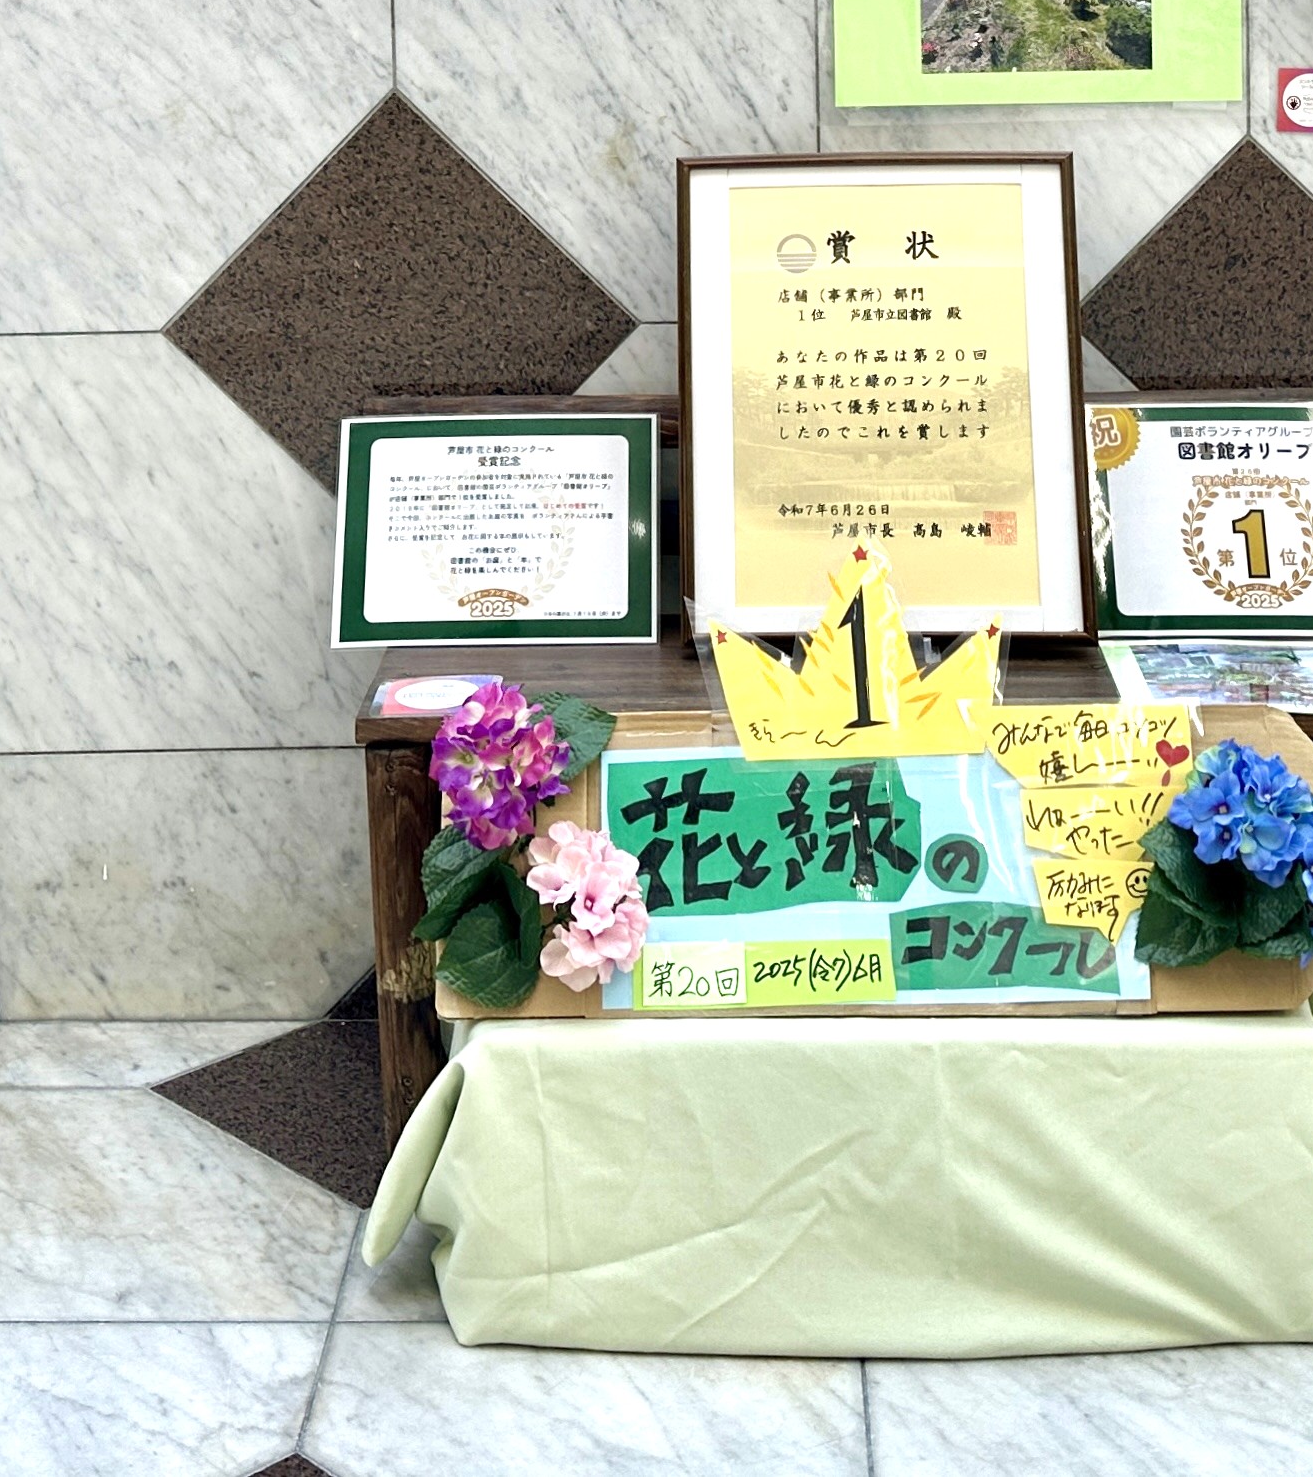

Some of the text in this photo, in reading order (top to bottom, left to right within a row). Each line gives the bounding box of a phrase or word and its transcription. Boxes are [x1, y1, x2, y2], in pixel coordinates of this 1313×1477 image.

[850, 308, 932, 322] 芦屋市立図書館
[947, 306, 962, 321] 殿
[776, 348, 987, 364] あなたの作品は第20回
[776, 374, 988, 390] 芦屋市花と緑のコンクール
[777, 399, 988, 415] において優秀と認められま
[779, 424, 990, 440] したのでこれを賞します
[1170, 425, 1313, 438] 園芸ボランティアグループ
[1177, 441, 1313, 460] 図書館オリーブ
[778, 504, 890, 517] 令和7年6月26日
[832, 523, 895, 539] 芦屋市長
[1217, 509, 1298, 578] 第 1 位
[470, 600, 515, 618] 2025
[1240, 593, 1281, 609] 2025
[838, 585, 891, 729] 1
[621, 761, 981, 912] 花と緑の
[649, 959, 741, 999] 第20回
